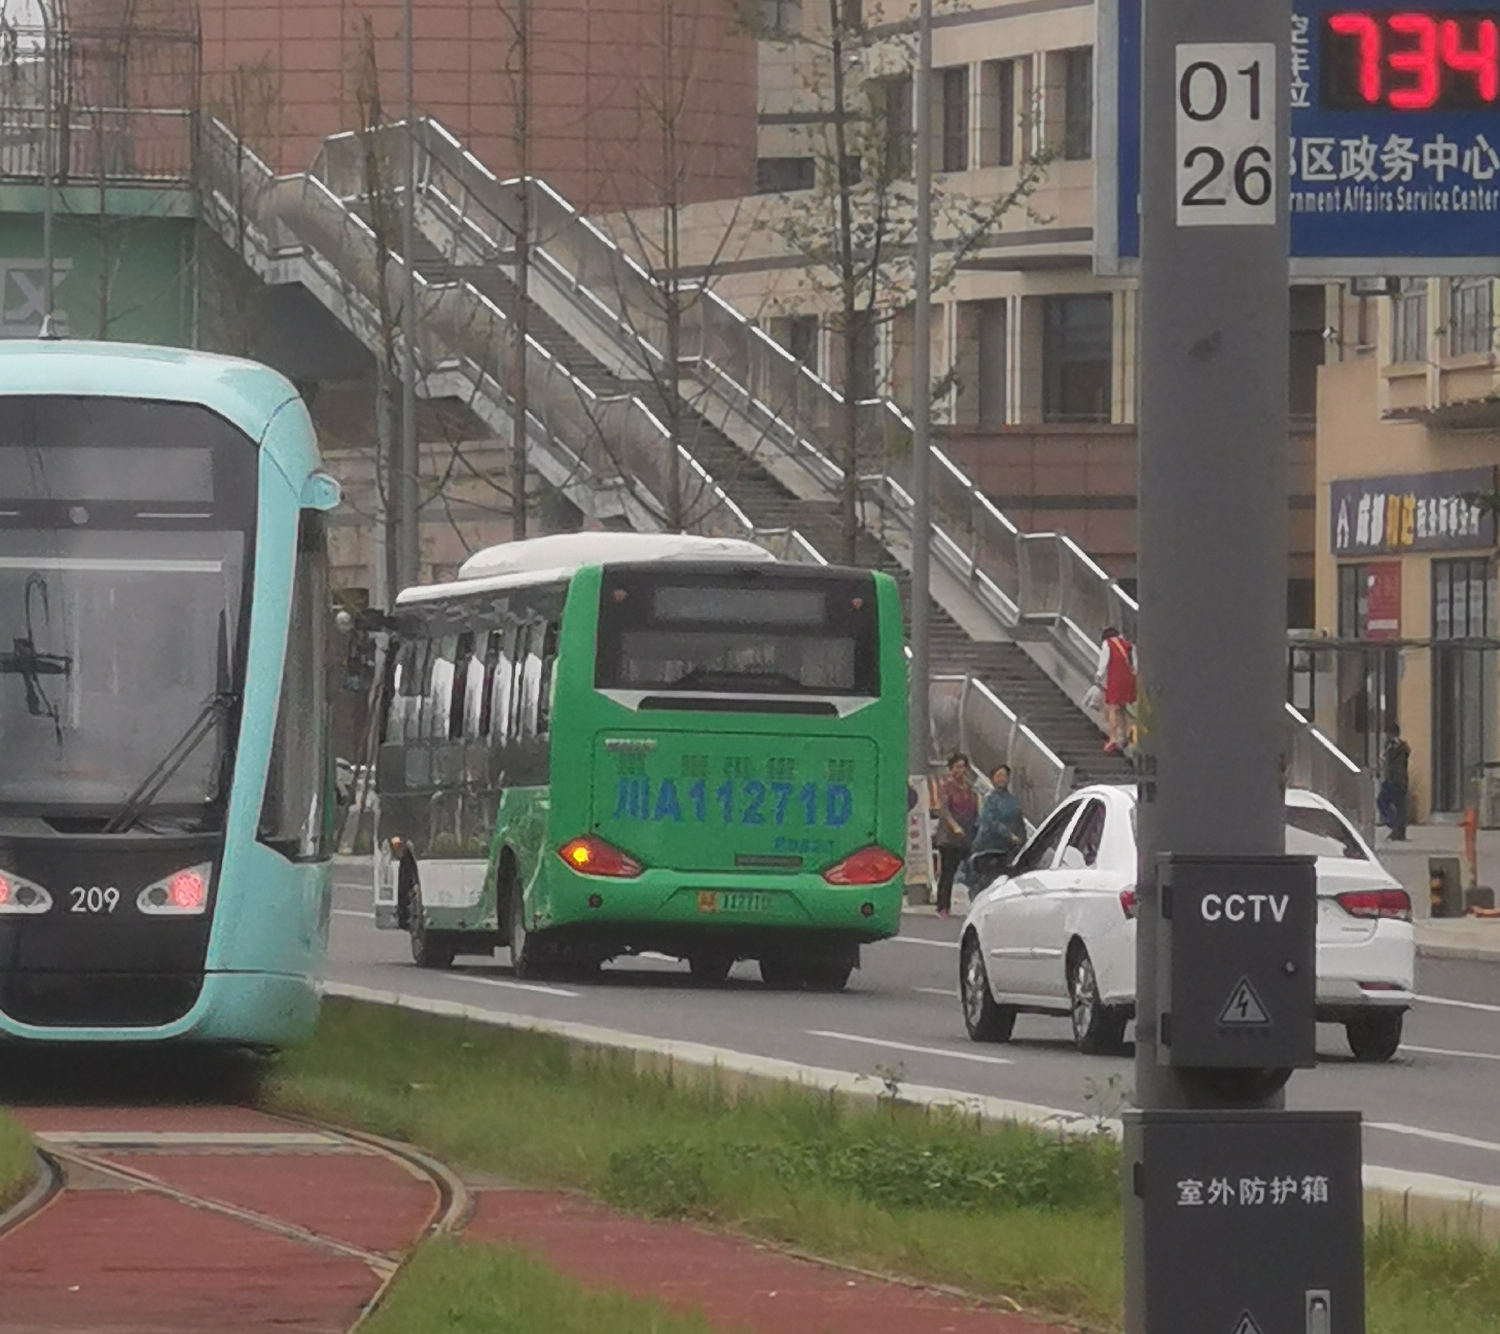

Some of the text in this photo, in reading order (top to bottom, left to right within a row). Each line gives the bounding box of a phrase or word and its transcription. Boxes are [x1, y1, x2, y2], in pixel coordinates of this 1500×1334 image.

[1329, 13, 1499, 110] 734
[1179, 60, 1261, 122] 01
[1180, 145, 1272, 207] 26
[1290, 133, 1500, 183] 区政务中心
[1290, 184, 1499, 213] rnment Affairs Service Center
[614, 775, 853, 828] 川A11271D
[70, 887, 120, 912] 209
[1201, 893, 1289, 923] CCTV
[1176, 1175, 1329, 1206] 室外防护箱
